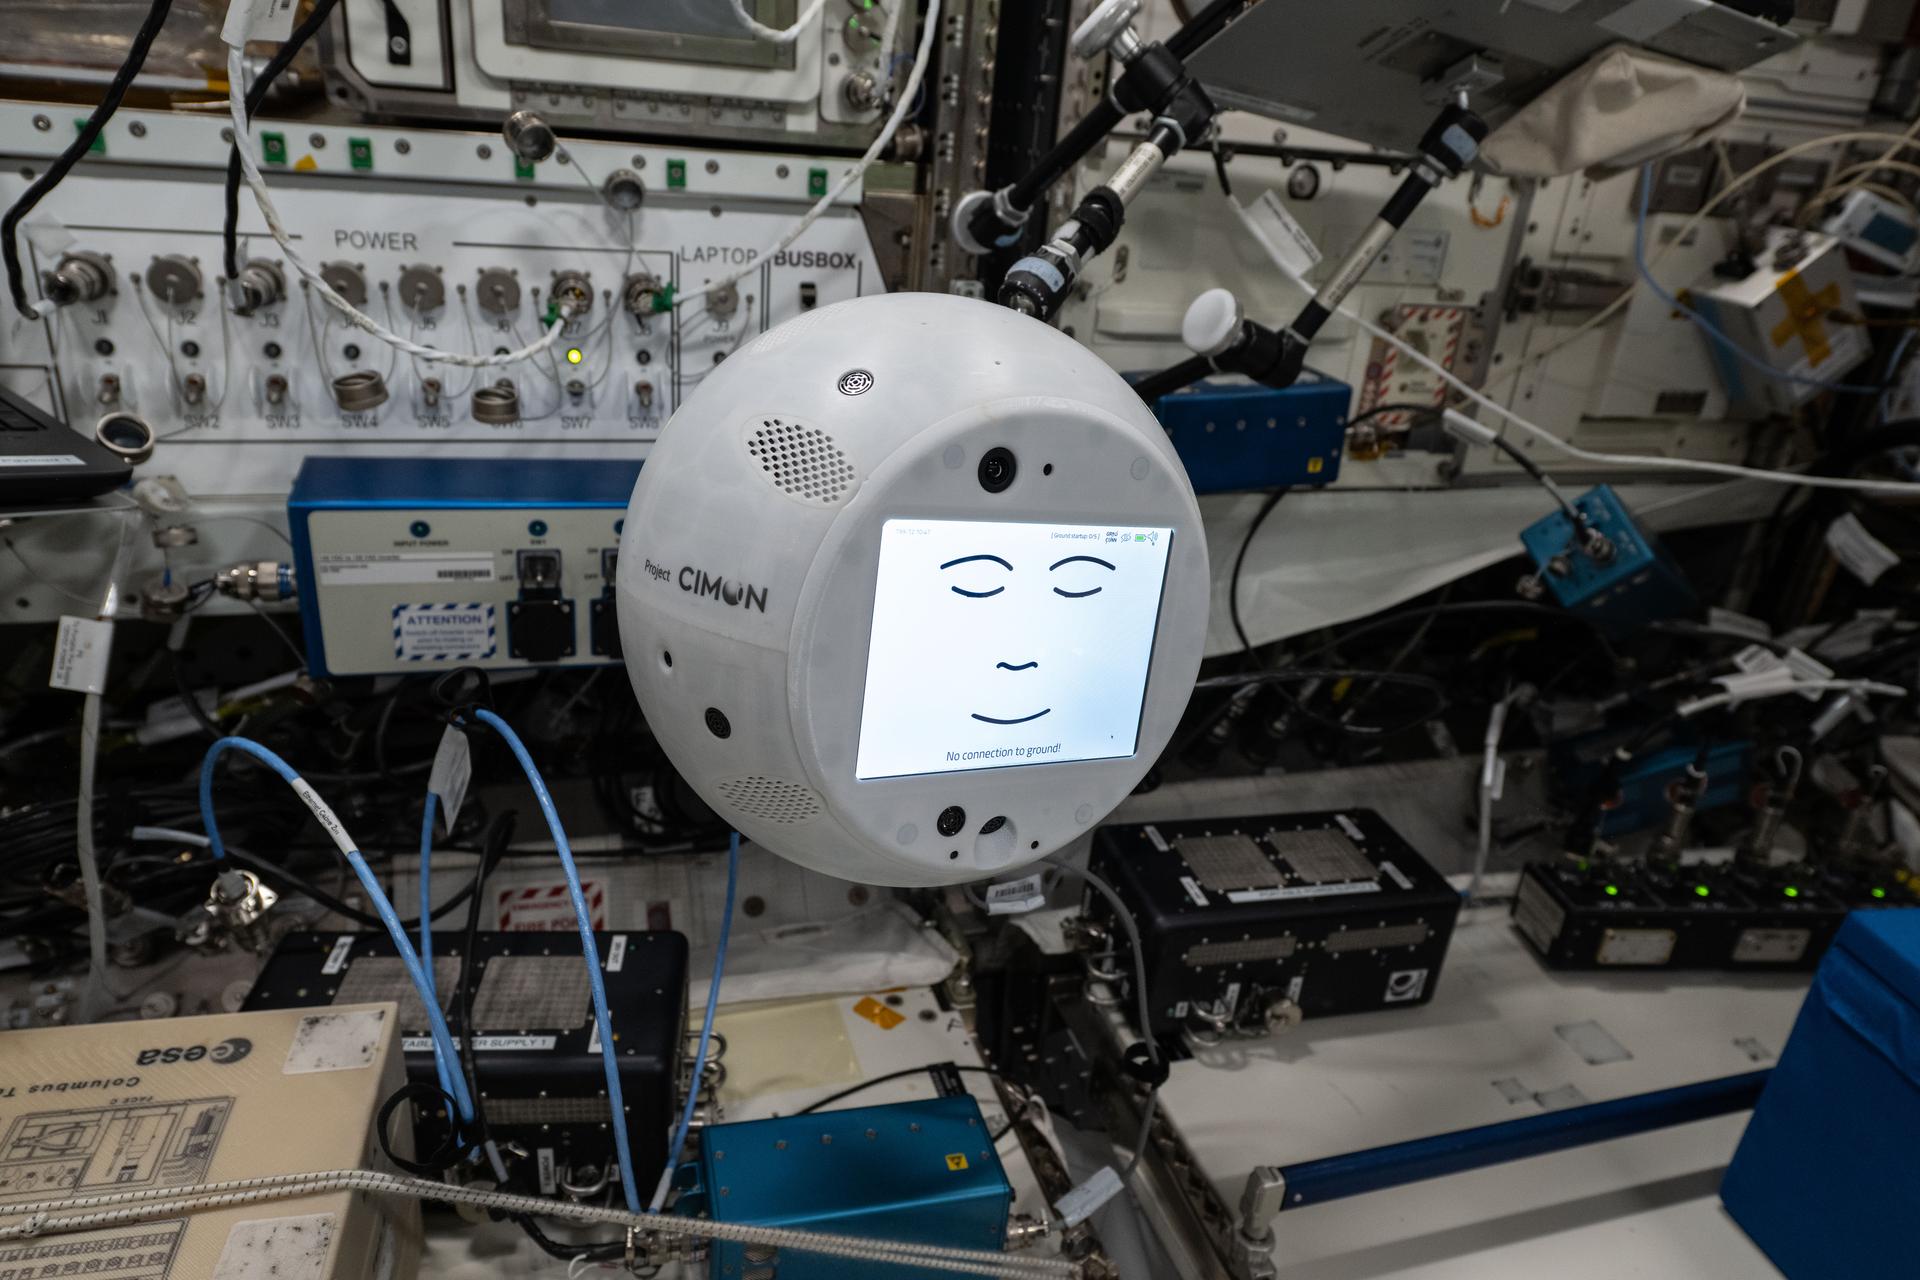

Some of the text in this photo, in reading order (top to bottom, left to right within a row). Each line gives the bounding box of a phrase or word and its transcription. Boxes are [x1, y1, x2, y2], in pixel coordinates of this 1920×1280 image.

[334, 229, 418, 251] POWER
[680, 246, 758, 264] LAPTOP
[773, 250, 857, 269] BUSBOX
[92, 309, 108, 325] J1
[259, 311, 279, 327] J3
[184, 415, 220, 429] SW2
[265, 415, 300, 429] SW3
[341, 414, 380, 429] SW4
[417, 414, 451, 429] SW5
[561, 416, 592, 430] SW7
[644, 559, 768, 613] Project CIMON
[407, 614, 482, 625] ATTENTION
[946, 743, 1062, 761] No connection to ground!
[136, 1044, 207, 1066] esa
[29, 1076, 140, 1095] Columbus
